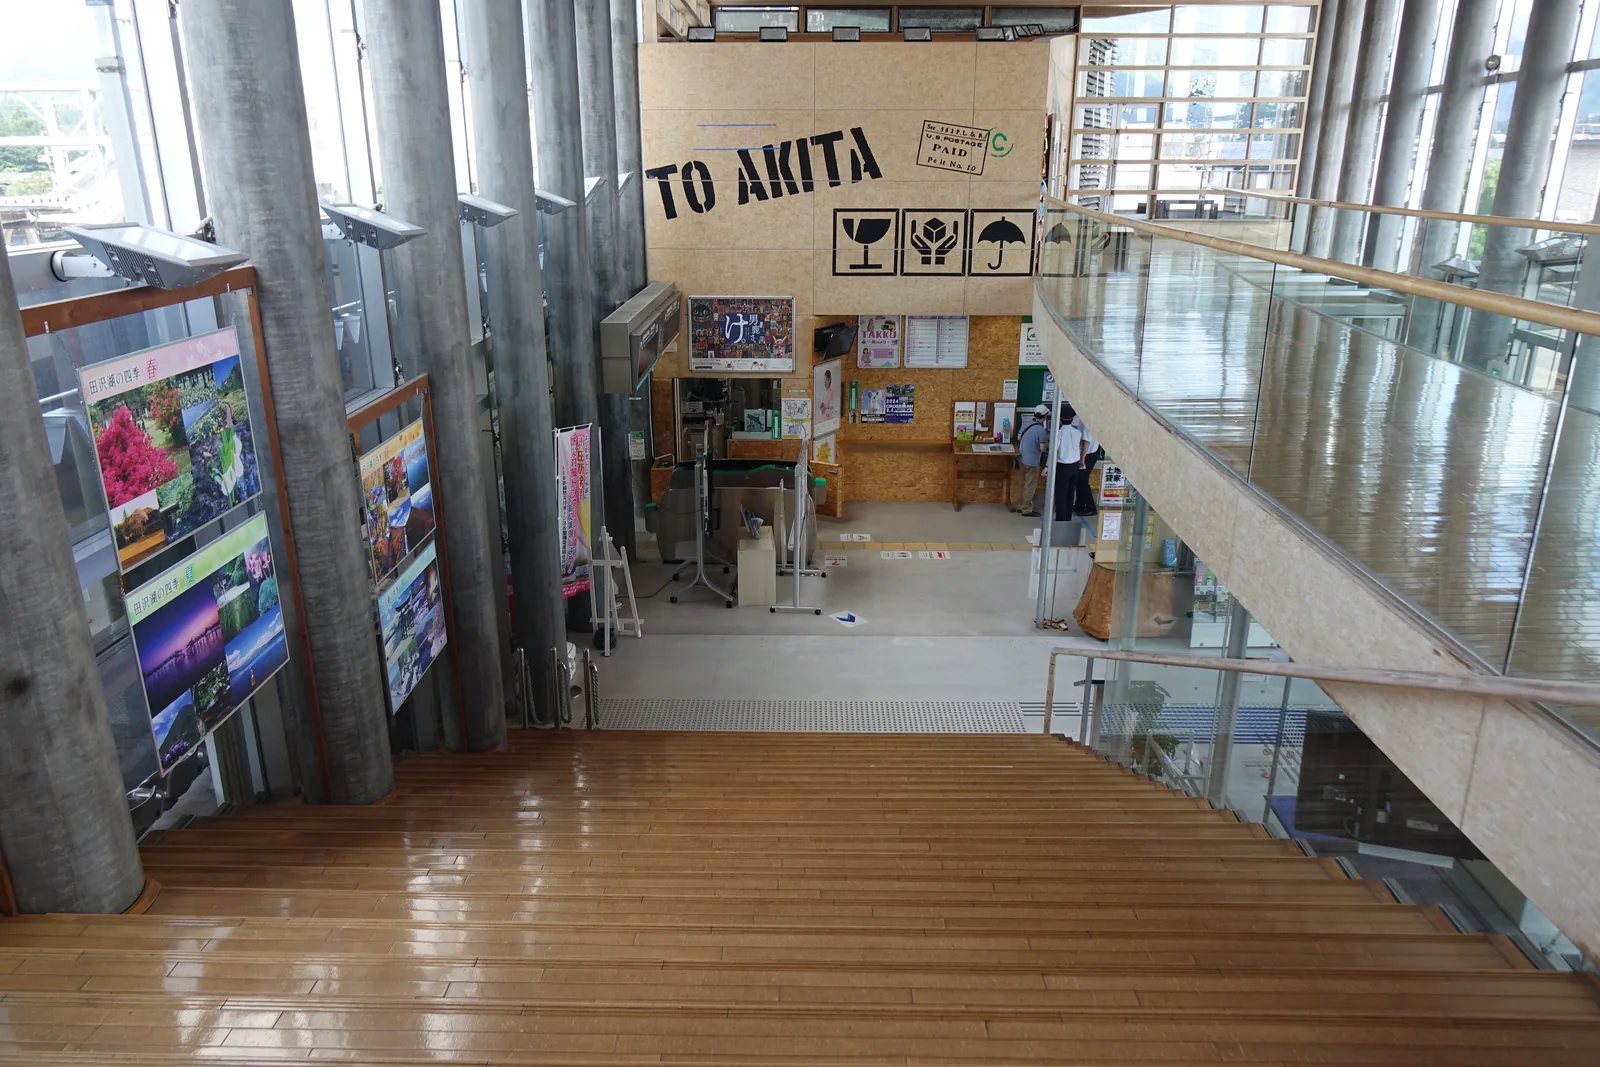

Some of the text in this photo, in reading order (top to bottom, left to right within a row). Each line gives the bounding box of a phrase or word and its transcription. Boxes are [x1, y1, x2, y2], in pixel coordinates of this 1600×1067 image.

[932, 143, 968, 157] PAID
[967, 164, 976, 172] 10
[645, 126, 883, 220] TO AKITA
[88, 358, 157, 395] 田沢湖の四季 春
[133, 576, 180, 616] 田沢湖の四季
